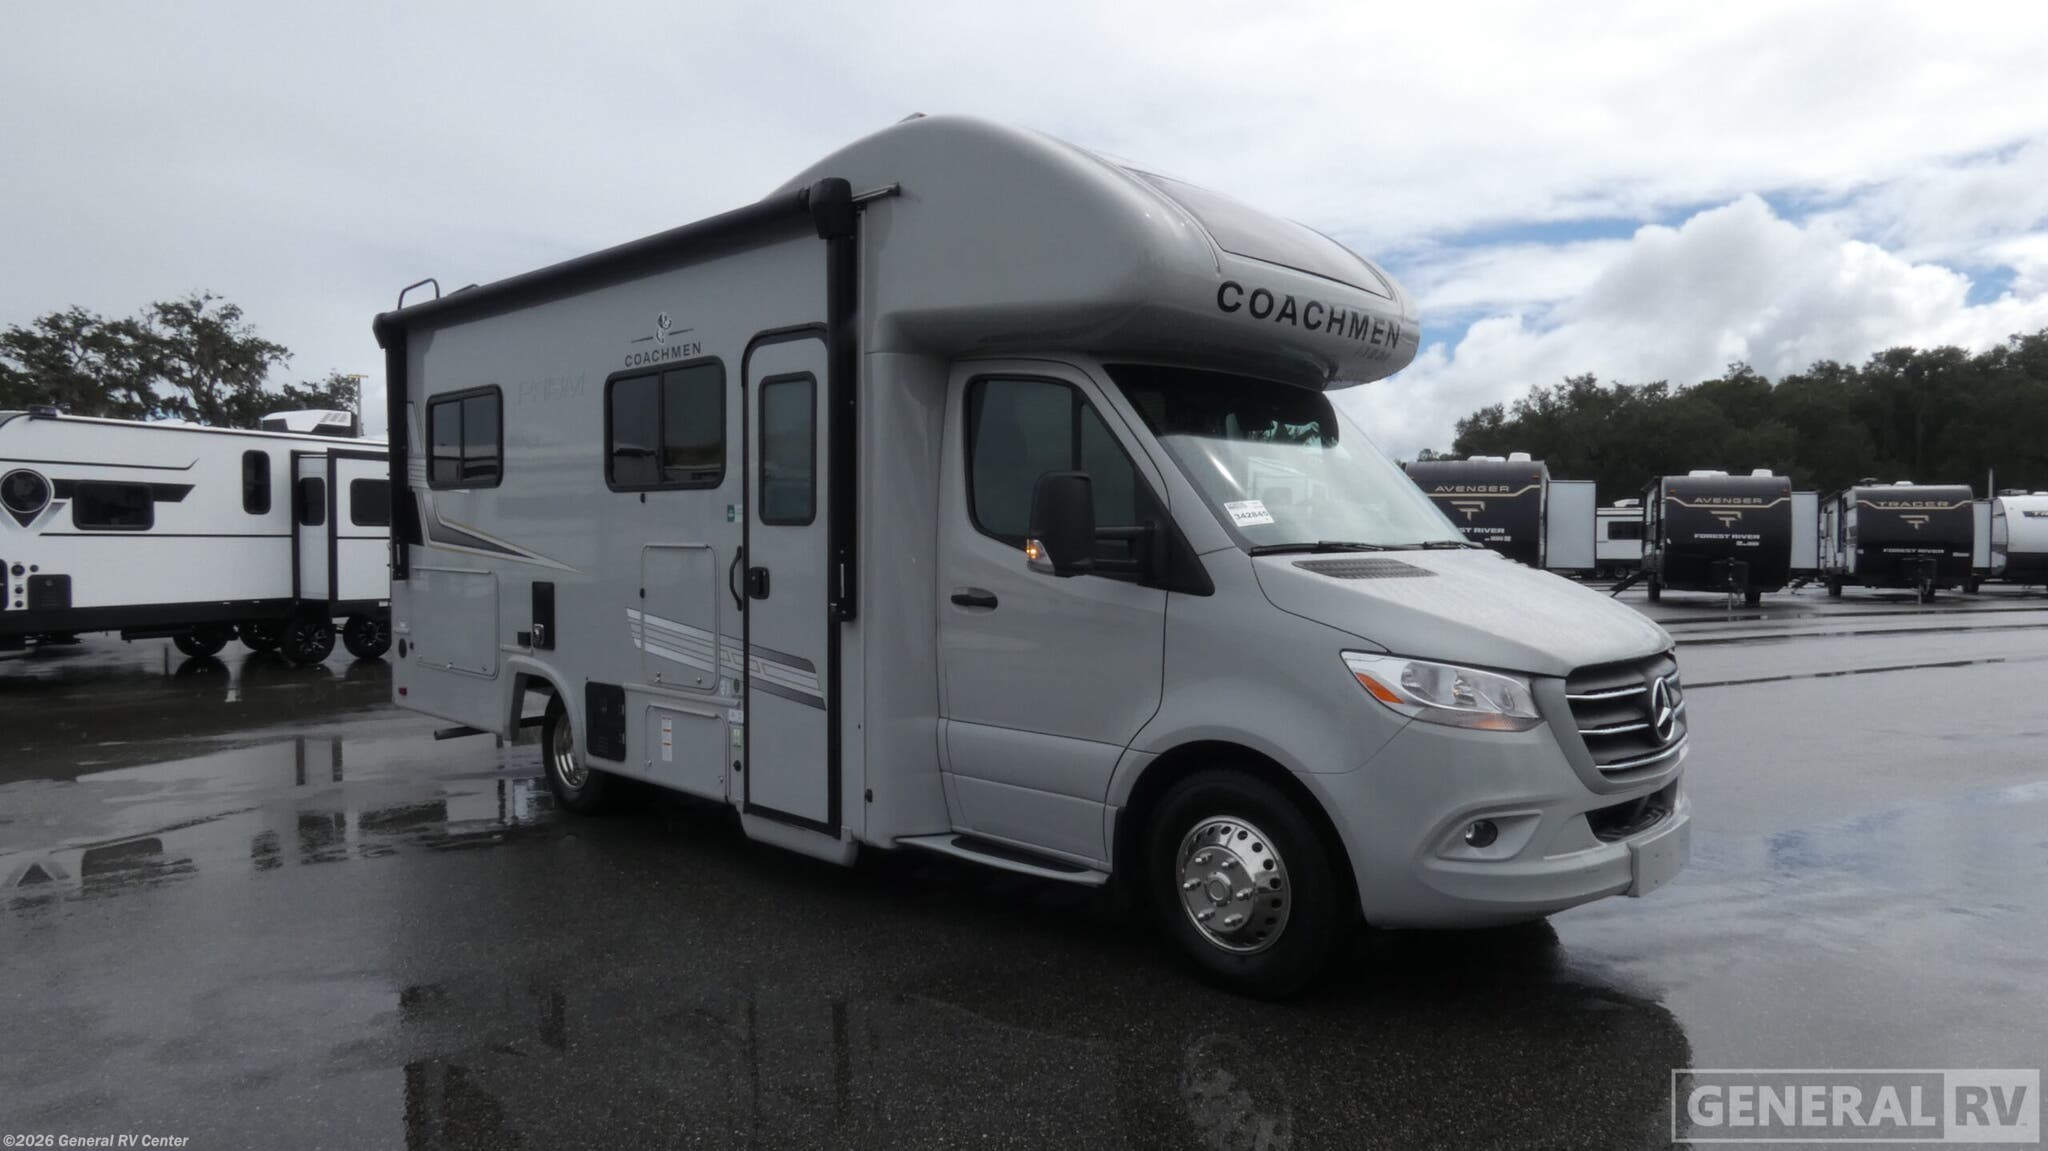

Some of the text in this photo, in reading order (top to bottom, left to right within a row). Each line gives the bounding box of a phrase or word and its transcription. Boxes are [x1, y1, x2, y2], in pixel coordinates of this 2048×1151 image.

[1216, 280, 1401, 349] COACHMEN
[624, 341, 702, 368] COACHMEN
[1434, 485, 1510, 493] AVENGER
